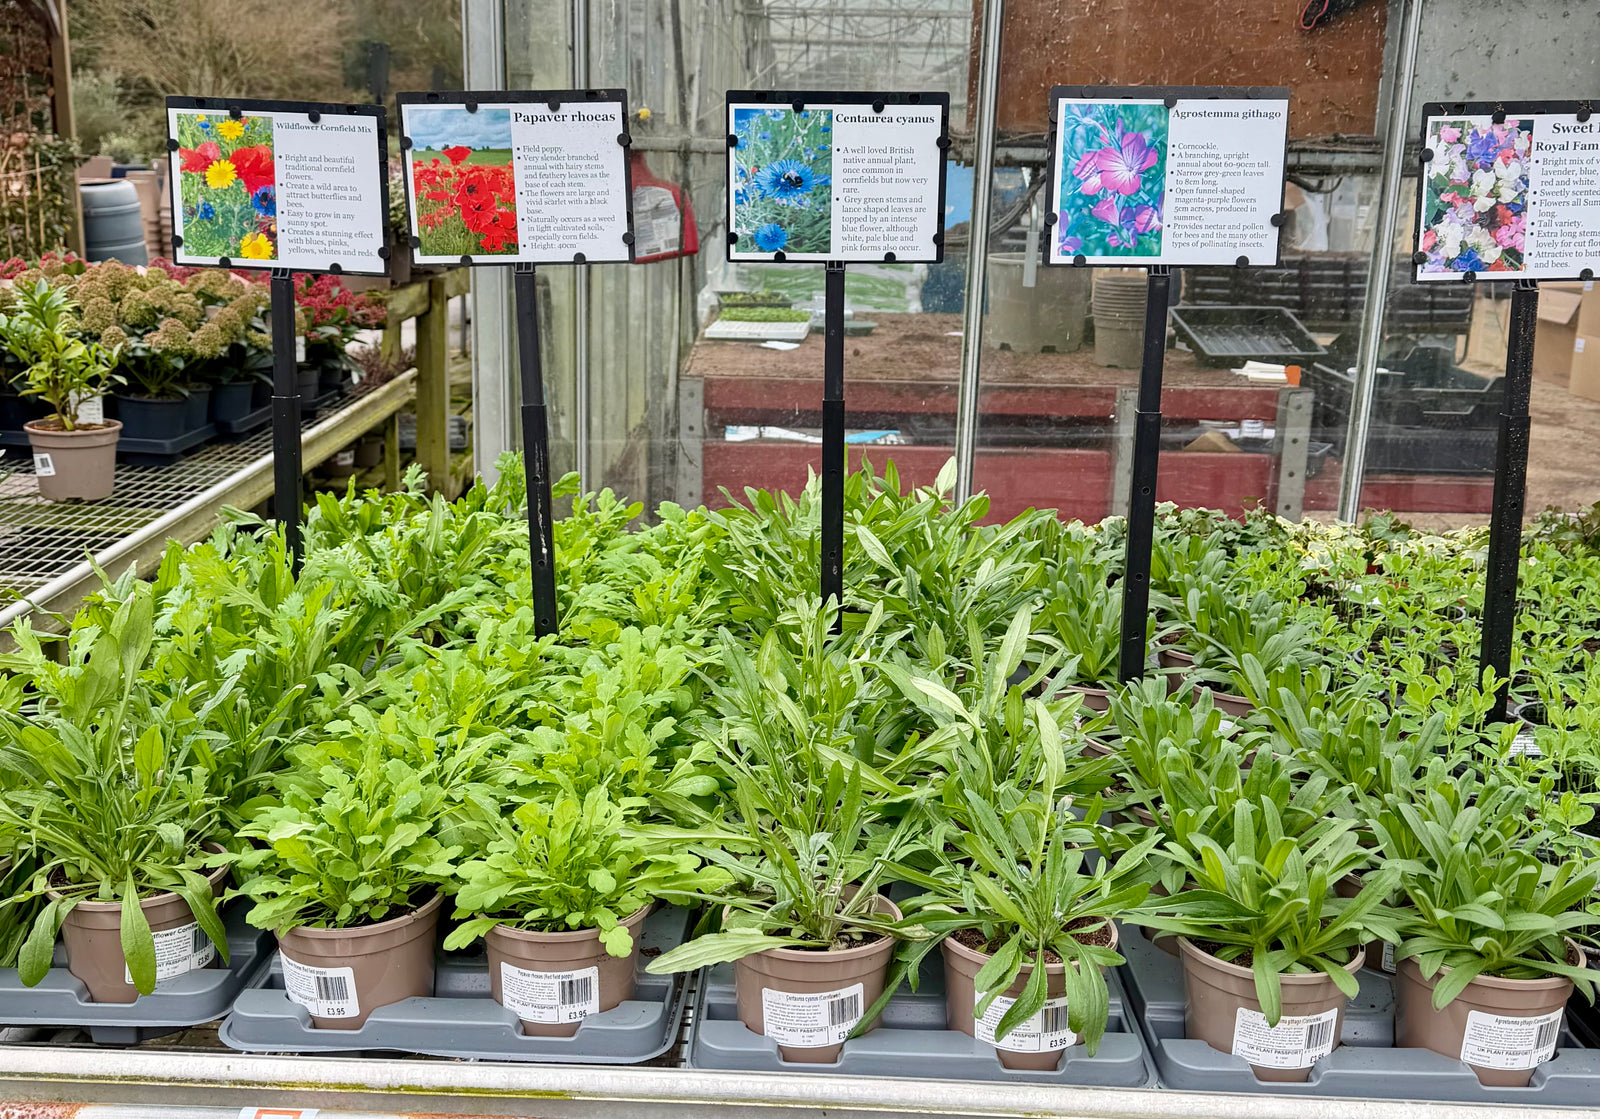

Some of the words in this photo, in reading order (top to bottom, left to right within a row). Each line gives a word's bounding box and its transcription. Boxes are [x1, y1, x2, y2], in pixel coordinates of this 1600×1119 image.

[514, 112, 568, 124] Papaver
[572, 112, 615, 121] rhoeas
[1173, 110, 1239, 119] Agrostemma
[1242, 110, 1281, 119] githago
[836, 114, 893, 123] Centaurea
[896, 117, 934, 125] cyanus
[277, 122, 319, 131] Wildflower
[321, 124, 356, 132] Cornfield
[358, 124, 371, 133] Mix
[1552, 124, 1593, 132] Sweet
[1536, 142, 1569, 152] Royal
[285, 154, 307, 163] Bright
[895, 157, 916, 165] plant,
[1542, 157, 1567, 166] Bright
[1540, 189, 1570, 197] Sweetly
[844, 196, 862, 204] Grey
[863, 206, 889, 214] shaped
[1538, 209, 1558, 218] long.
[842, 215, 868, 223] topped
[870, 215, 878, 223] by
[1555, 219, 1584, 228] variety.
[886, 225, 918, 233] although
[1560, 230, 1577, 238] long
[866, 235, 881, 243] pale
[842, 244, 858, 252] pink
[1536, 240, 1559, 249] lovely
[568, 1010, 587, 1020] £3.95
[1050, 1038, 1066, 1048] £3.95
